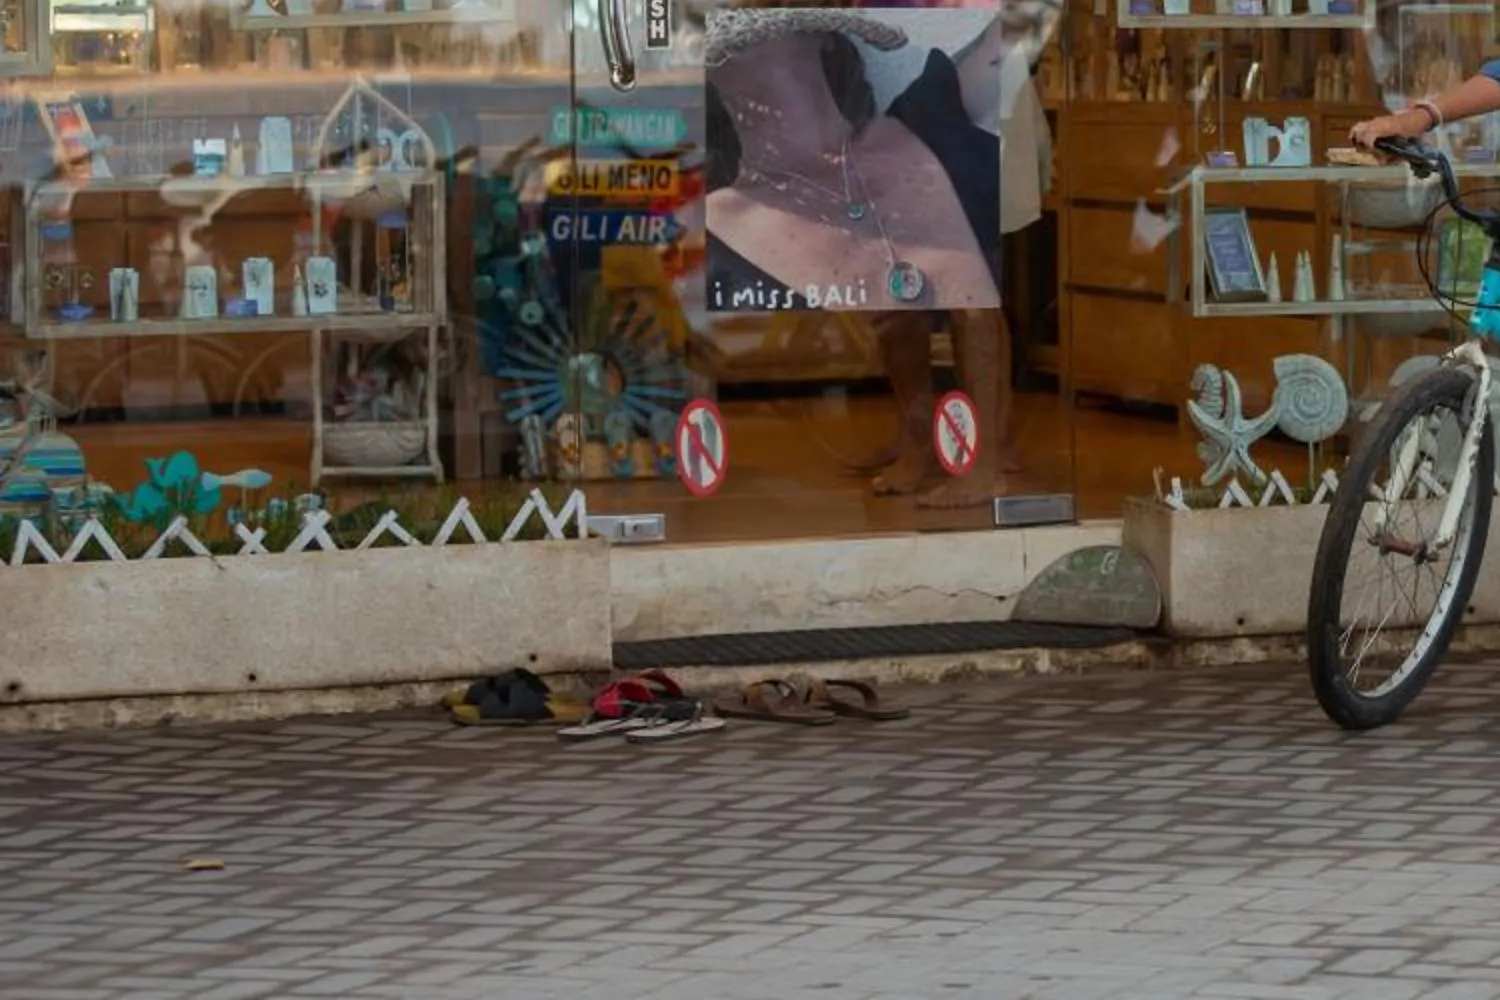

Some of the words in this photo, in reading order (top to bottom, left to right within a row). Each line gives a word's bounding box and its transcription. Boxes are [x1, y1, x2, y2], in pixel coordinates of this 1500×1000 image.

[607, 164, 672, 190] MENO
[551, 214, 607, 241] GILI
[616, 214, 667, 242] AIR
